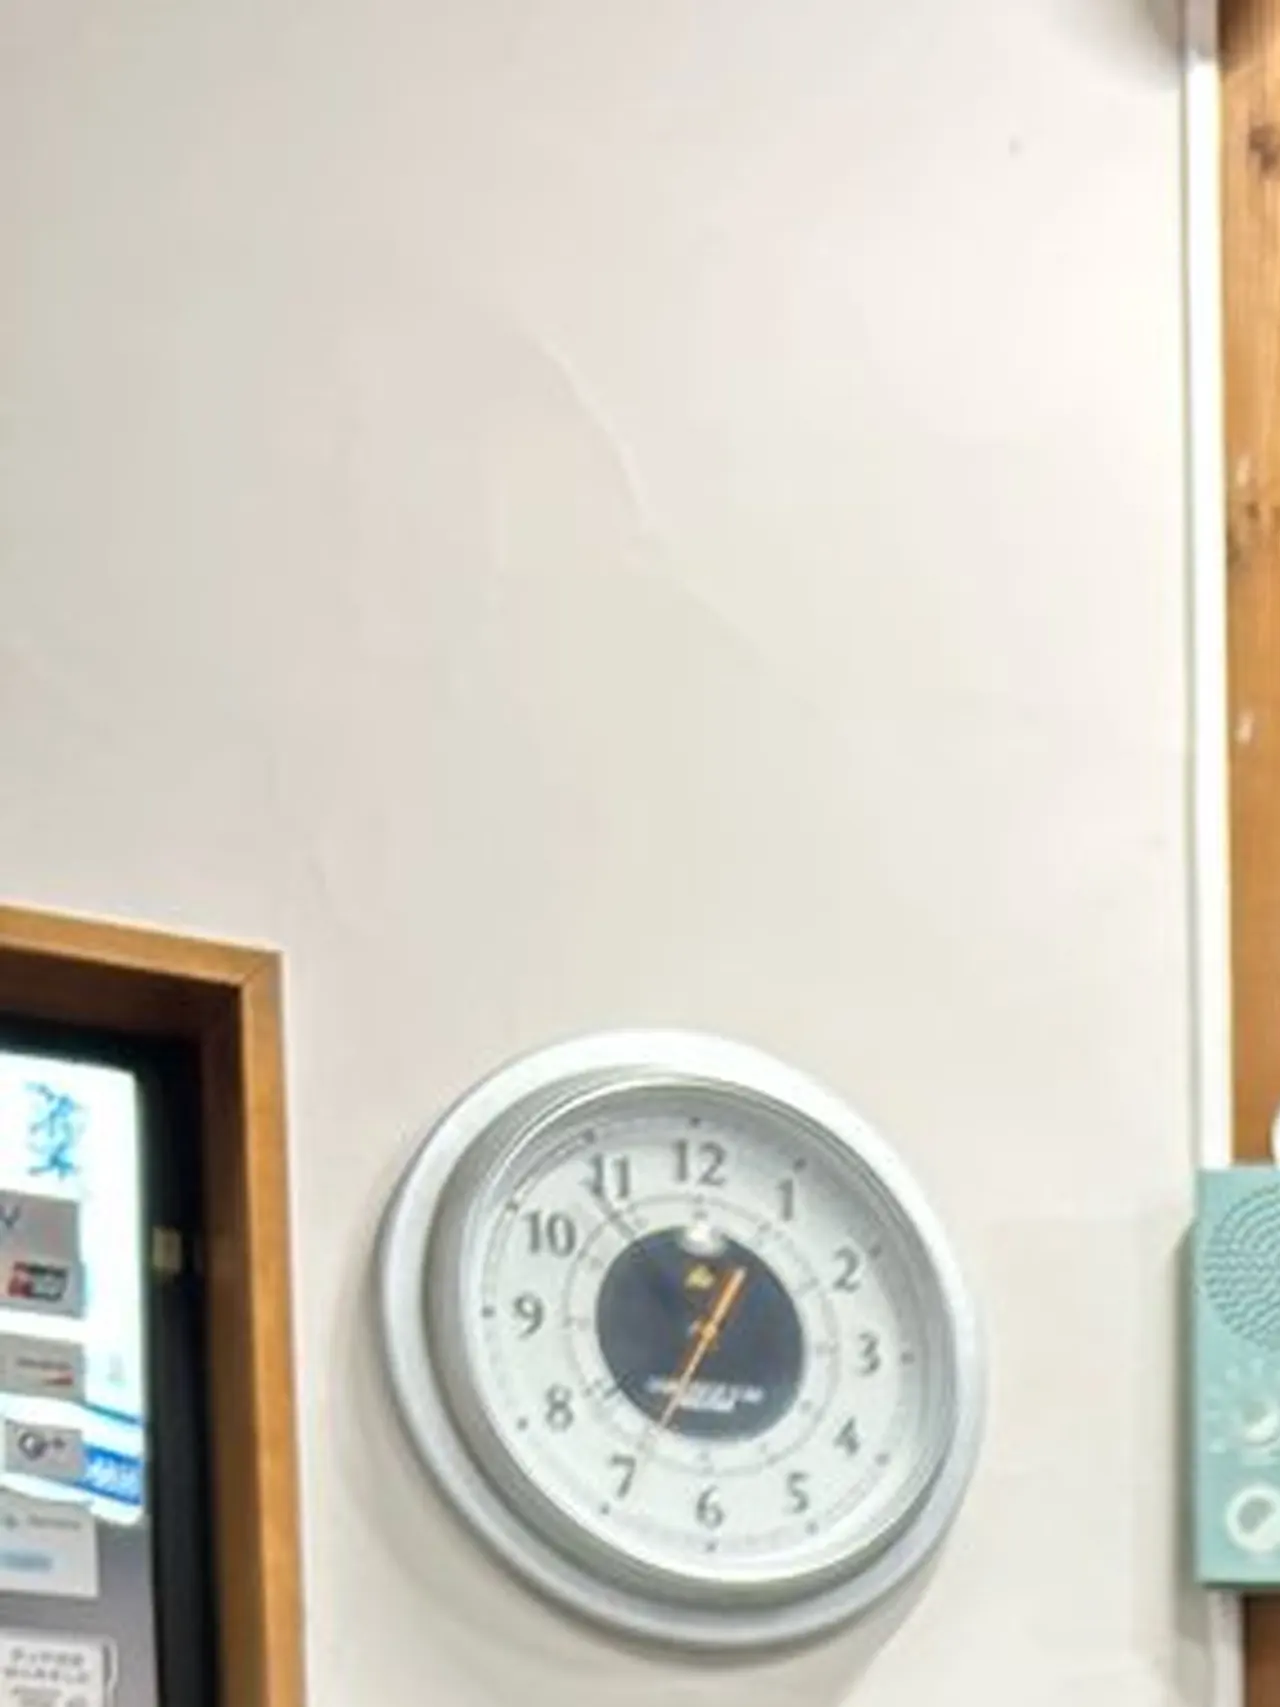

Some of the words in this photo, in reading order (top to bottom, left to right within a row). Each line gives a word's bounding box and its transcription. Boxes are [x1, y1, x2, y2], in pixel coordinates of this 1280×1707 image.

[586, 1154, 631, 1199] 11
[671, 1138, 727, 1187] 12
[776, 1177, 796, 1221] 1
[523, 1211, 576, 1257] 10
[833, 1248, 861, 1292] 2
[514, 1293, 544, 1336] 9
[855, 1333, 881, 1376] 3
[545, 1385, 574, 1431] 8
[833, 1417, 861, 1457] 4
[611, 1456, 636, 1499] 7
[786, 1472, 809, 1514] 5
[697, 1485, 724, 1530] 6
